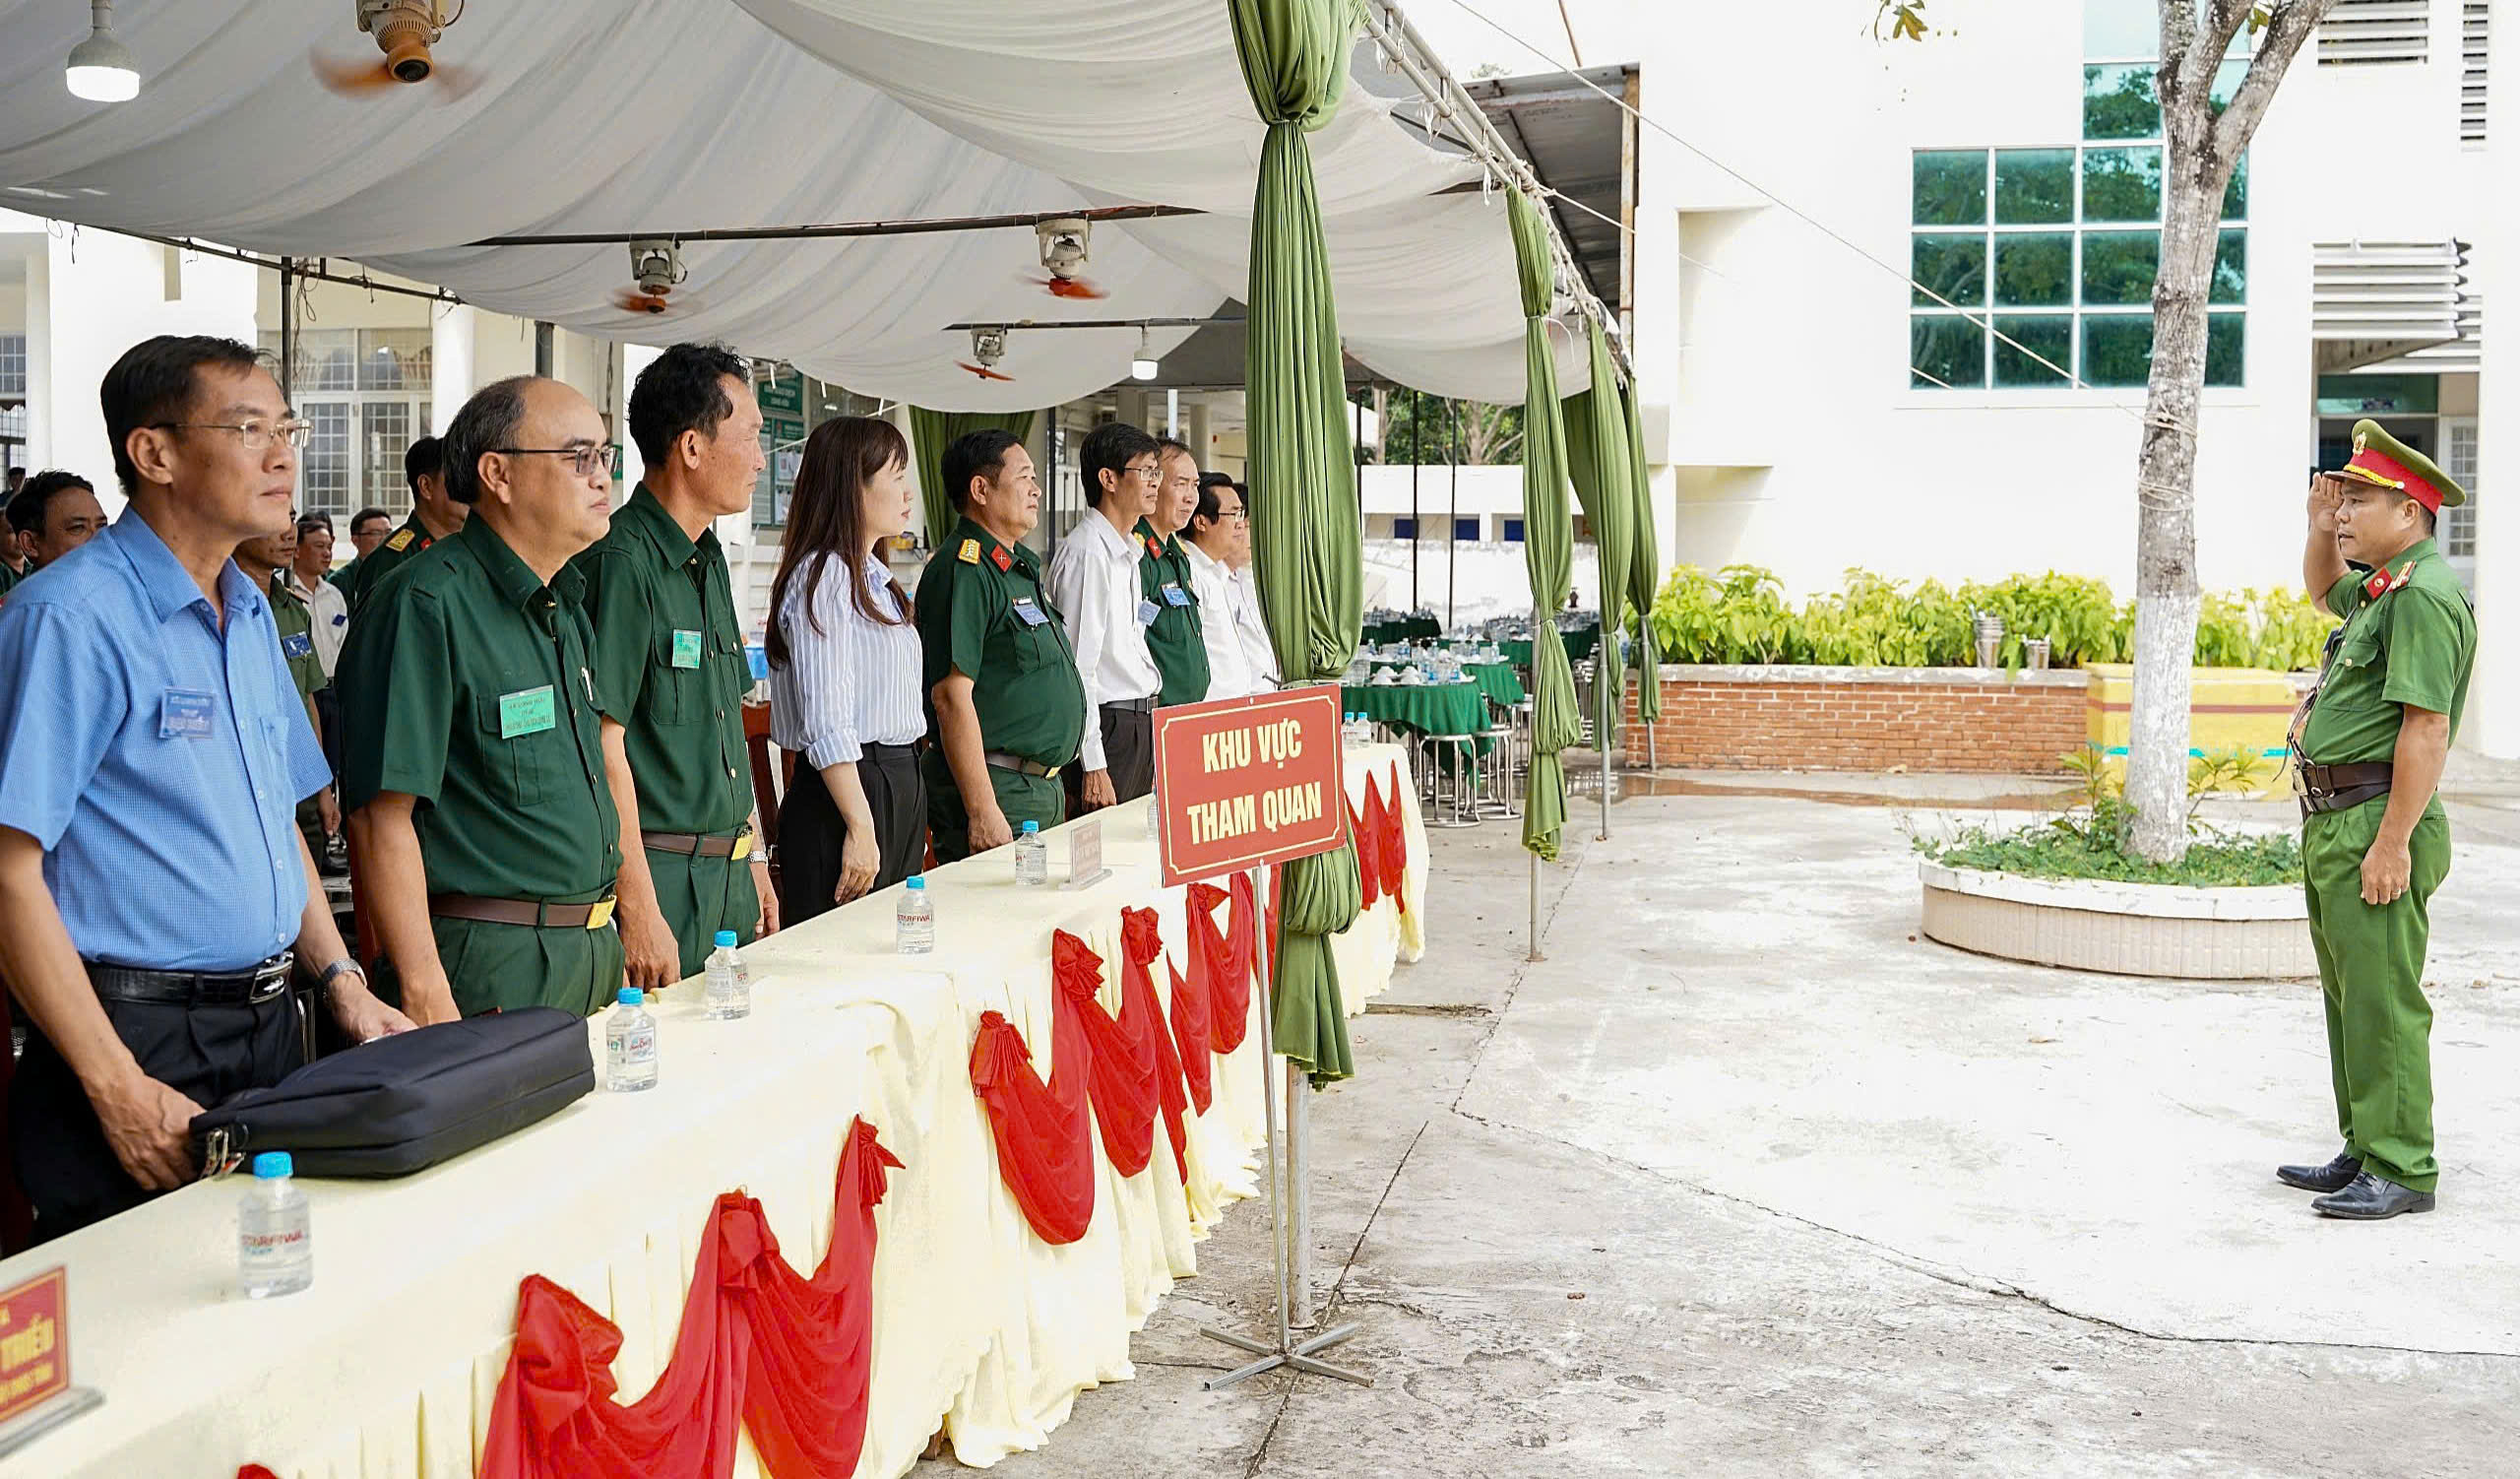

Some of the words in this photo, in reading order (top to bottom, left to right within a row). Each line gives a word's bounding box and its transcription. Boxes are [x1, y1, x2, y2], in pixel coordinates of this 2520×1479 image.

[1202, 728, 1251, 773] KHU
[1257, 718, 1302, 769] VỰC
[1187, 795, 1257, 845] THAM
[1263, 781, 1322, 832] QUAN
